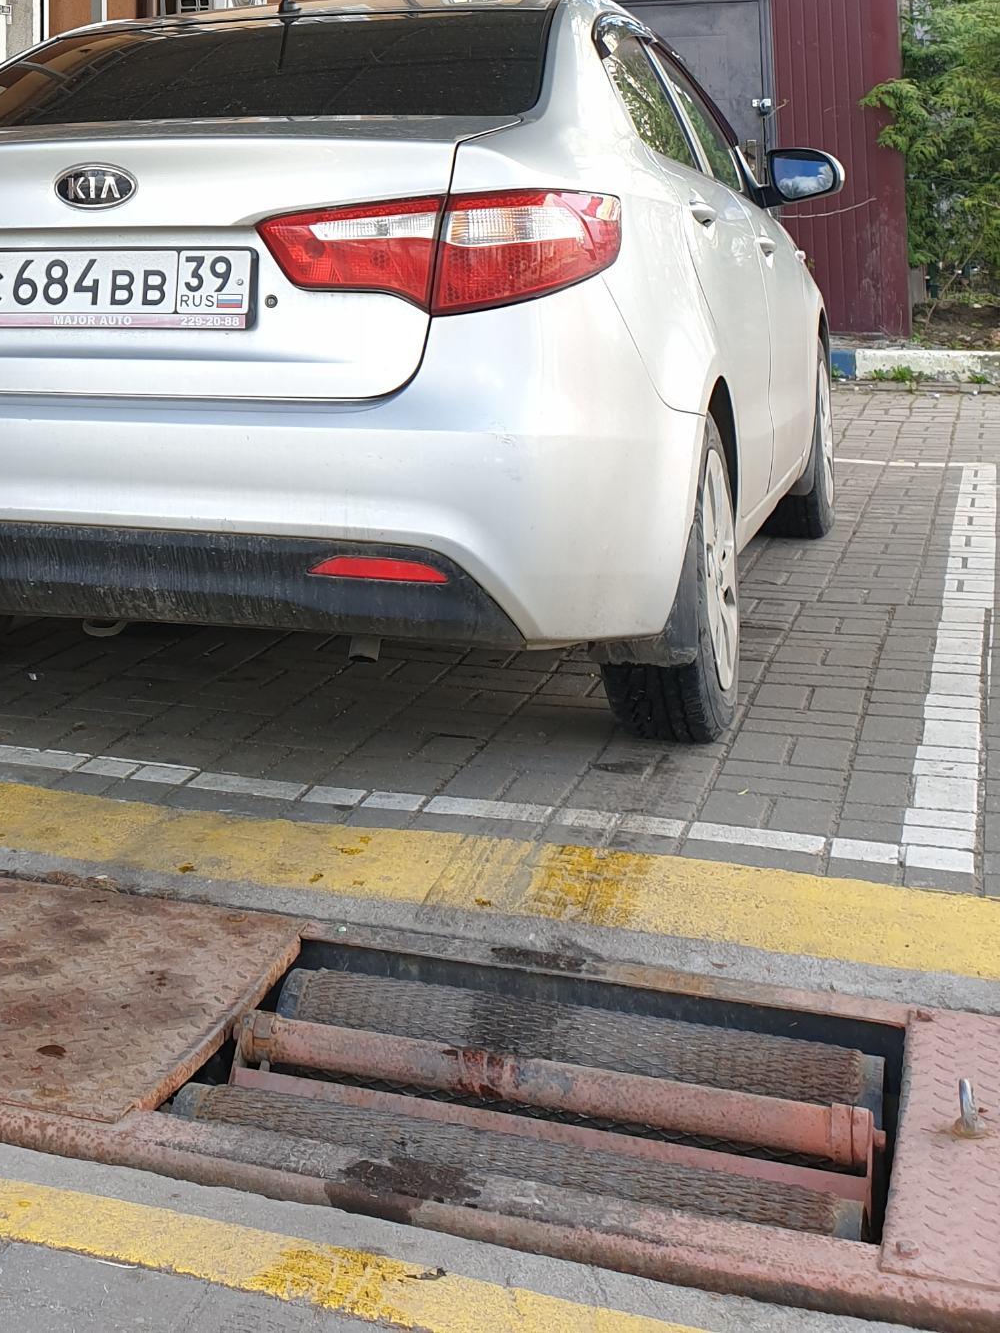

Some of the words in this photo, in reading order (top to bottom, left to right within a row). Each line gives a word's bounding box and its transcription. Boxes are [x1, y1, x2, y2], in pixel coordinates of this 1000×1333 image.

[67, 176, 121, 200] KIA
[183, 255, 232, 293] 39
[179, 294, 214, 308] RUS
[53, 314, 96, 325] MAJOR
[99, 315, 132, 325] AUTO
[179, 316, 240, 326] 229-20-88
